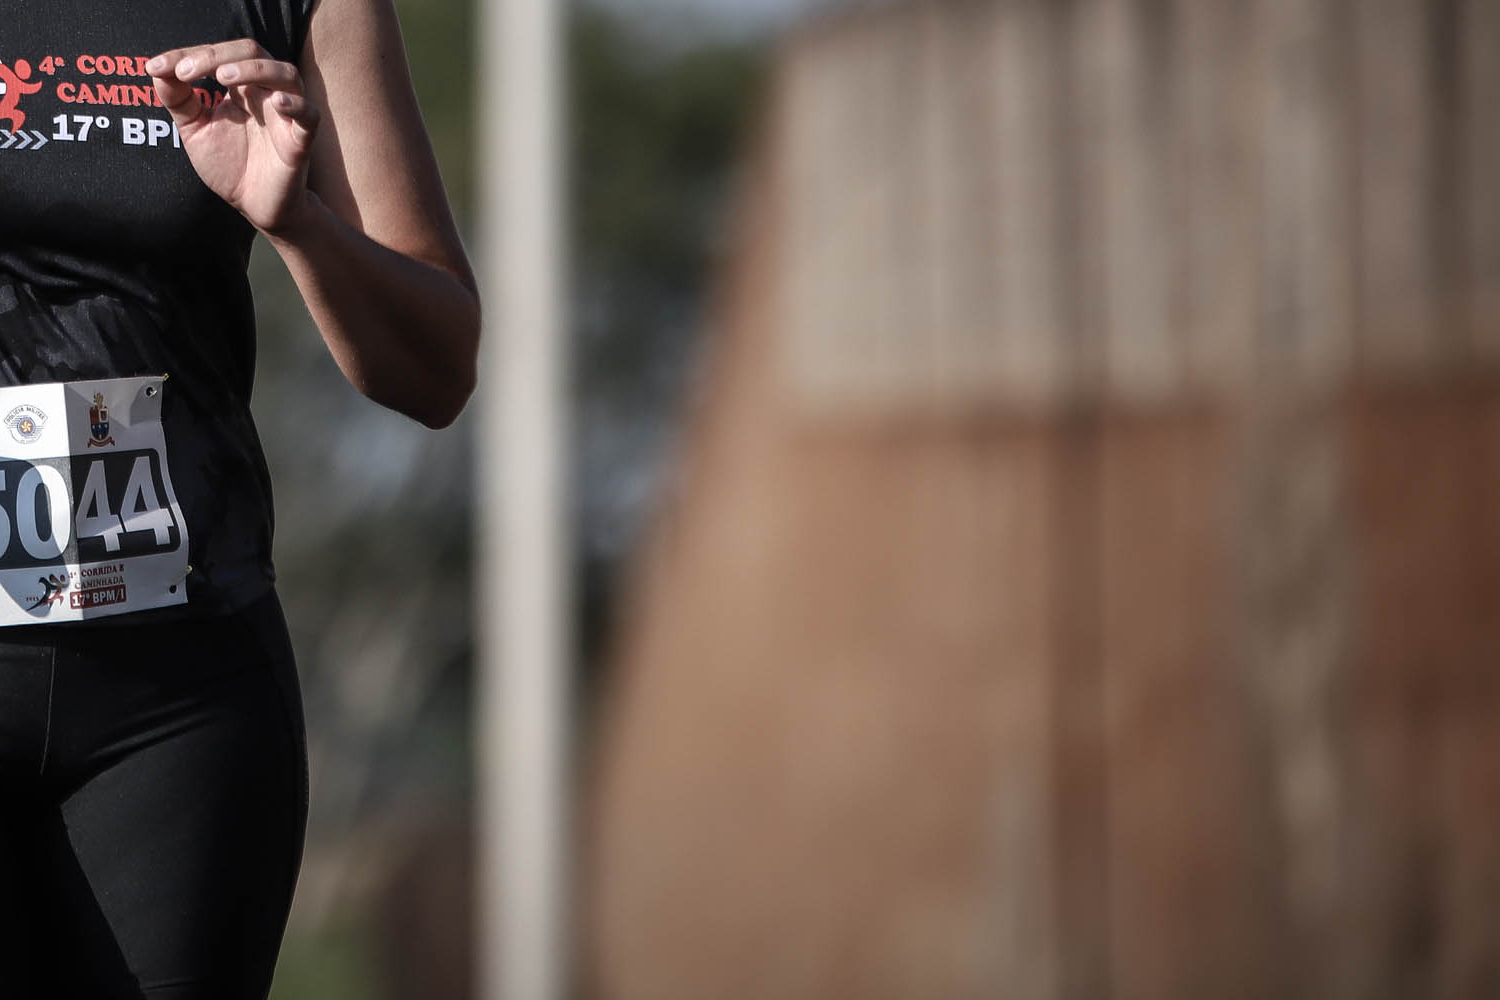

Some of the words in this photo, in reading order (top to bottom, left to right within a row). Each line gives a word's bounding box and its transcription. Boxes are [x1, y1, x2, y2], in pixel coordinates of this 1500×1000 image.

[81, 566, 117, 577] CORRIDA
[75, 576, 124, 589] CAMINHADA
[92, 588, 125, 604] BPM/I
